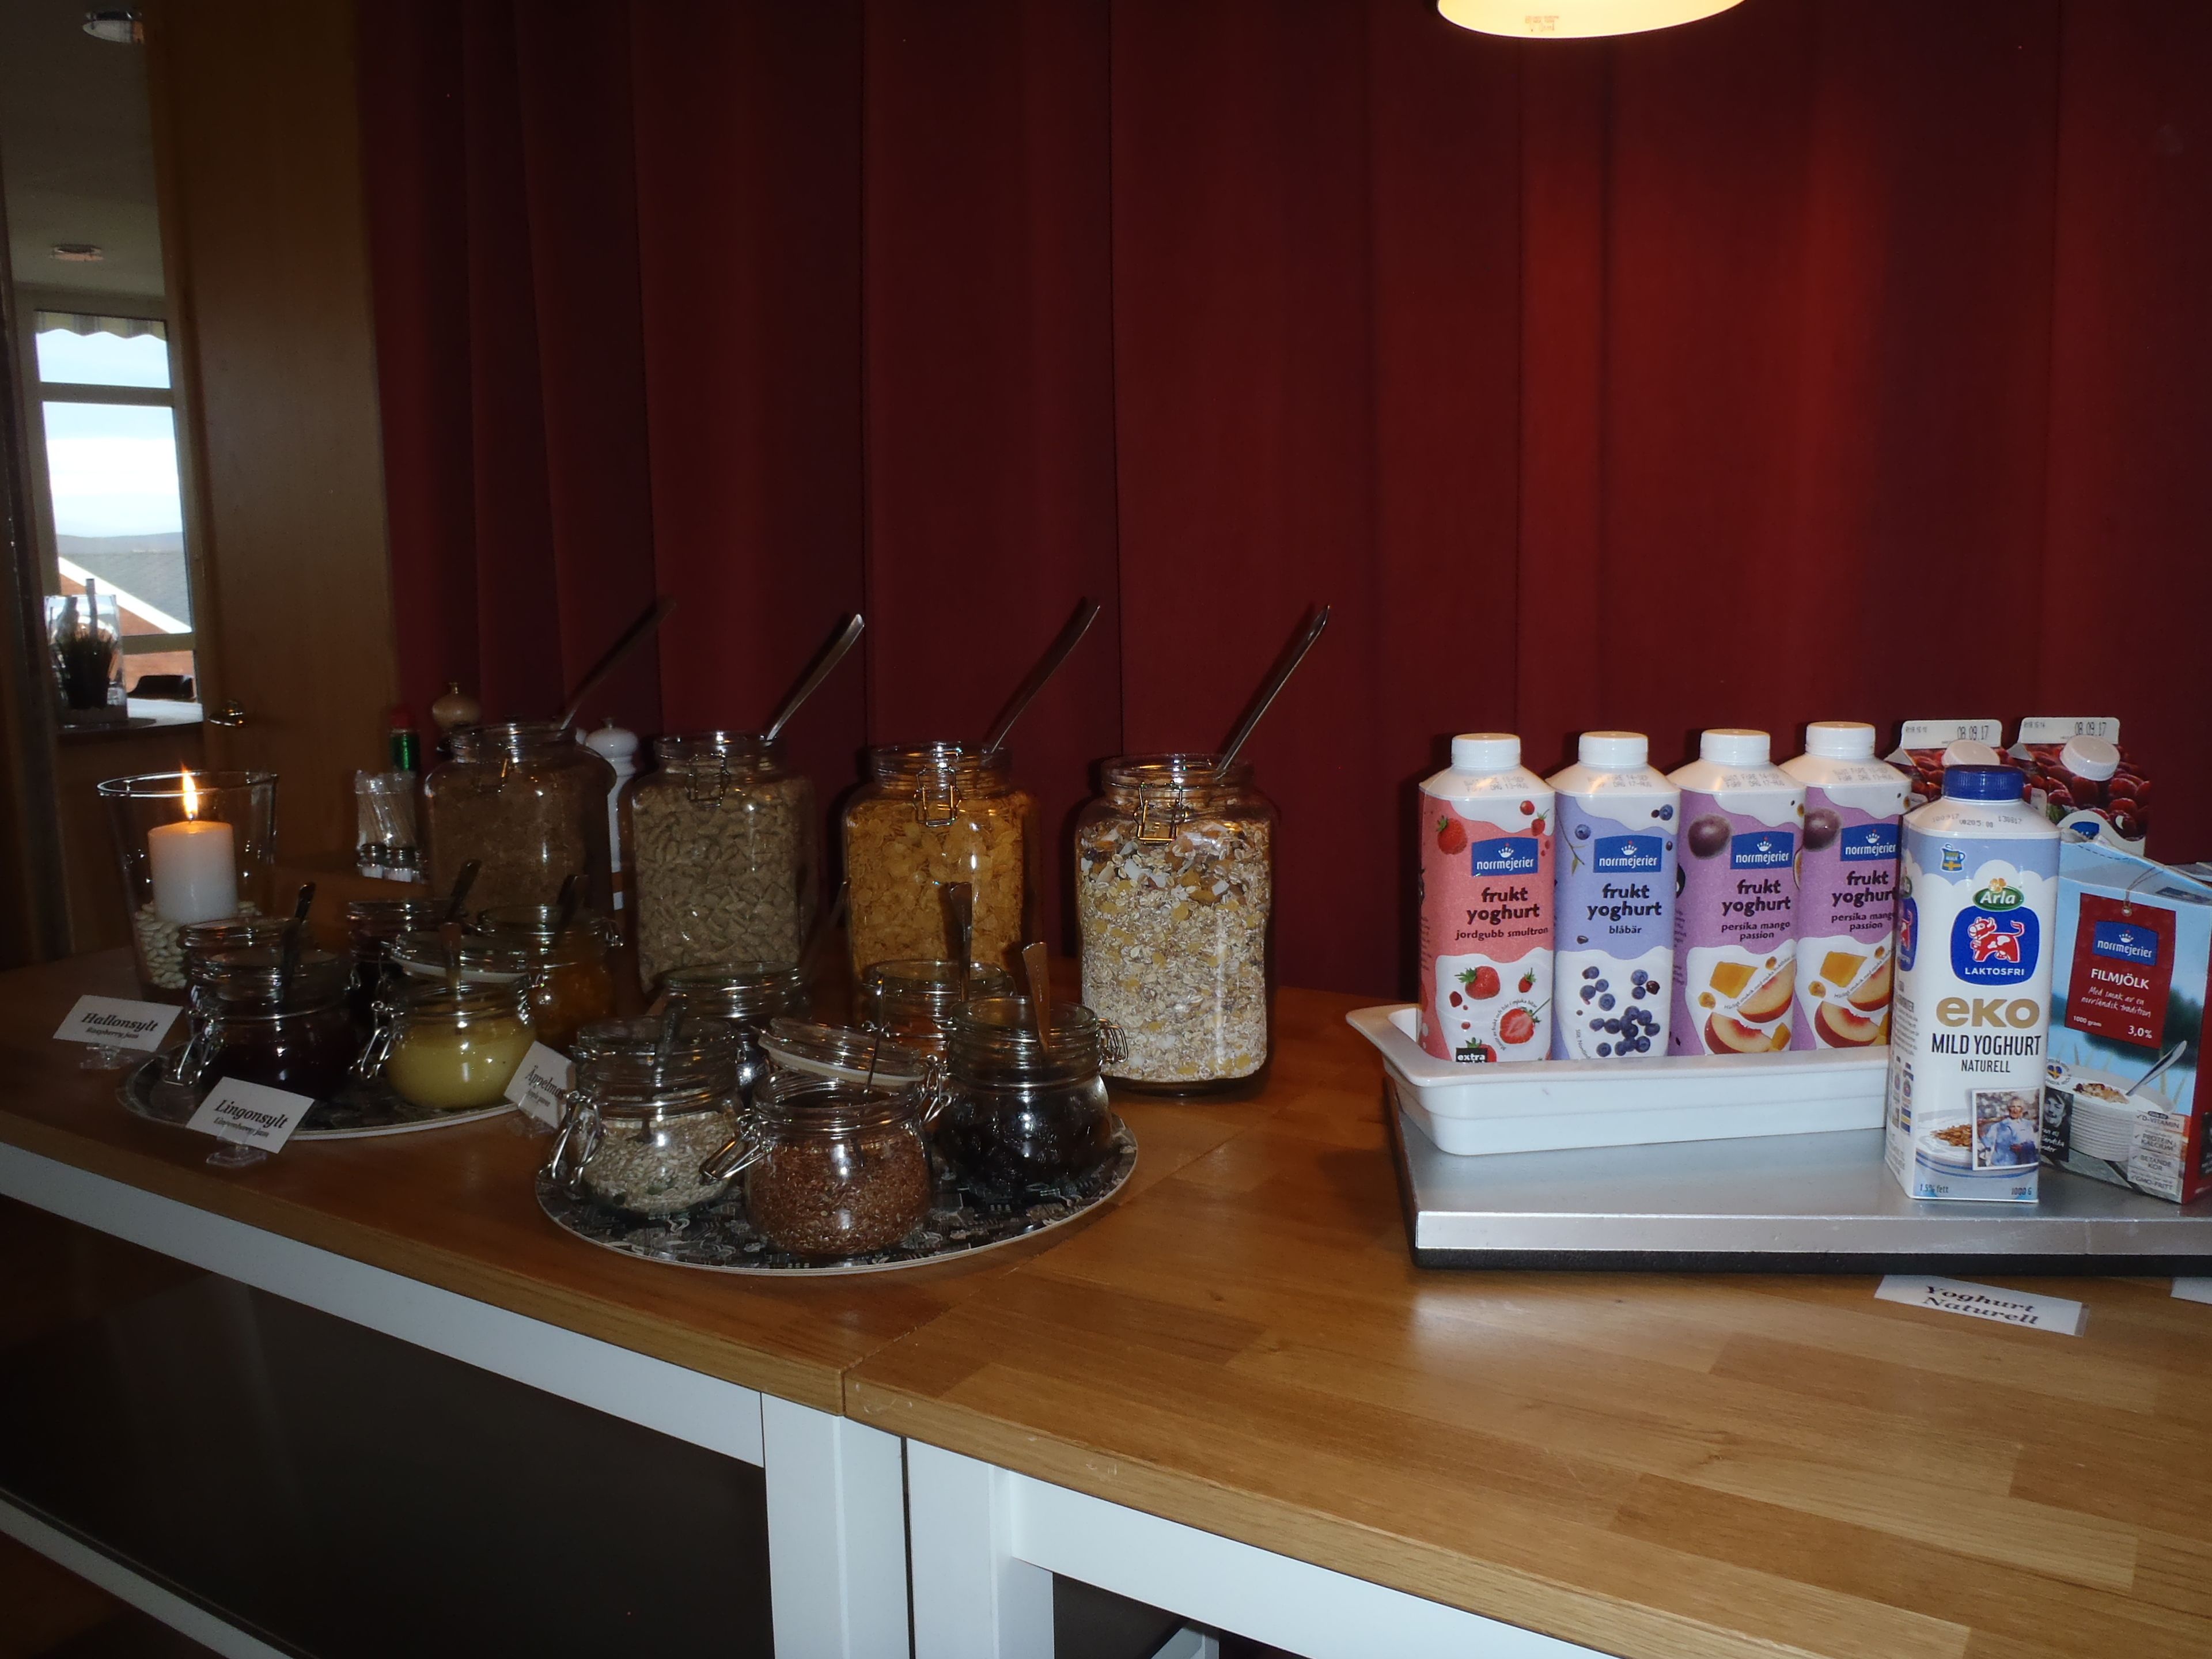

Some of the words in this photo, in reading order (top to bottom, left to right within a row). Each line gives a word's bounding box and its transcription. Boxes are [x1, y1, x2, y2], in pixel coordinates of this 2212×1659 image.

[1845, 842, 1896, 857] norrmejerier
[1476, 857, 1534, 872] norrmejerier
[1599, 855, 1658, 869] norrmejerier
[1736, 851, 1789, 865] norrmejerier
[1846, 870, 1889, 885] frukt
[1602, 883, 1650, 899] frukt
[1737, 878, 1781, 894] frukt
[1481, 887, 1528, 903] frukt
[1980, 892, 2016, 904] Arla
[1467, 903, 1540, 925] yoghurt
[1587, 900, 1662, 922] yoghurt
[1721, 896, 1791, 917] yoghurt
[1831, 912, 1867, 923] persika
[1455, 929, 1505, 941] jordgubb
[1507, 927, 1548, 937] smultron
[1609, 925, 1642, 934] blåbär
[1721, 922, 1757, 933] persika
[1760, 922, 1790, 931] mango
[1849, 922, 1883, 932] passion
[1740, 931, 1774, 942] passion
[2097, 940, 2152, 959] norrmejerier
[1965, 967, 2025, 976] LAKTOSFRI
[2090, 968, 2150, 990] FILMJÖLK
[2089, 986, 2103, 997] Med
[2105, 990, 2123, 1001] smak
[81, 1012, 159, 1032] Hallonsylt
[2128, 1025, 2153, 1039] 3,0%
[1931, 1033, 1969, 1055] MILD
[1974, 1035, 2041, 1056] YOGHURT
[1457, 1052, 1486, 1060] extra
[1961, 1059, 2011, 1073] NATURELL
[214, 1099, 290, 1129] Lingonsylt
[2142, 1115, 2180, 1129] D-VITAMIN
[2142, 1133, 2173, 1146] PROTEIN
[1936, 1184, 1949, 1194] fett
[1926, 1285, 2035, 1313] Yoghurt
[1922, 1297, 2039, 1325] Naturell
